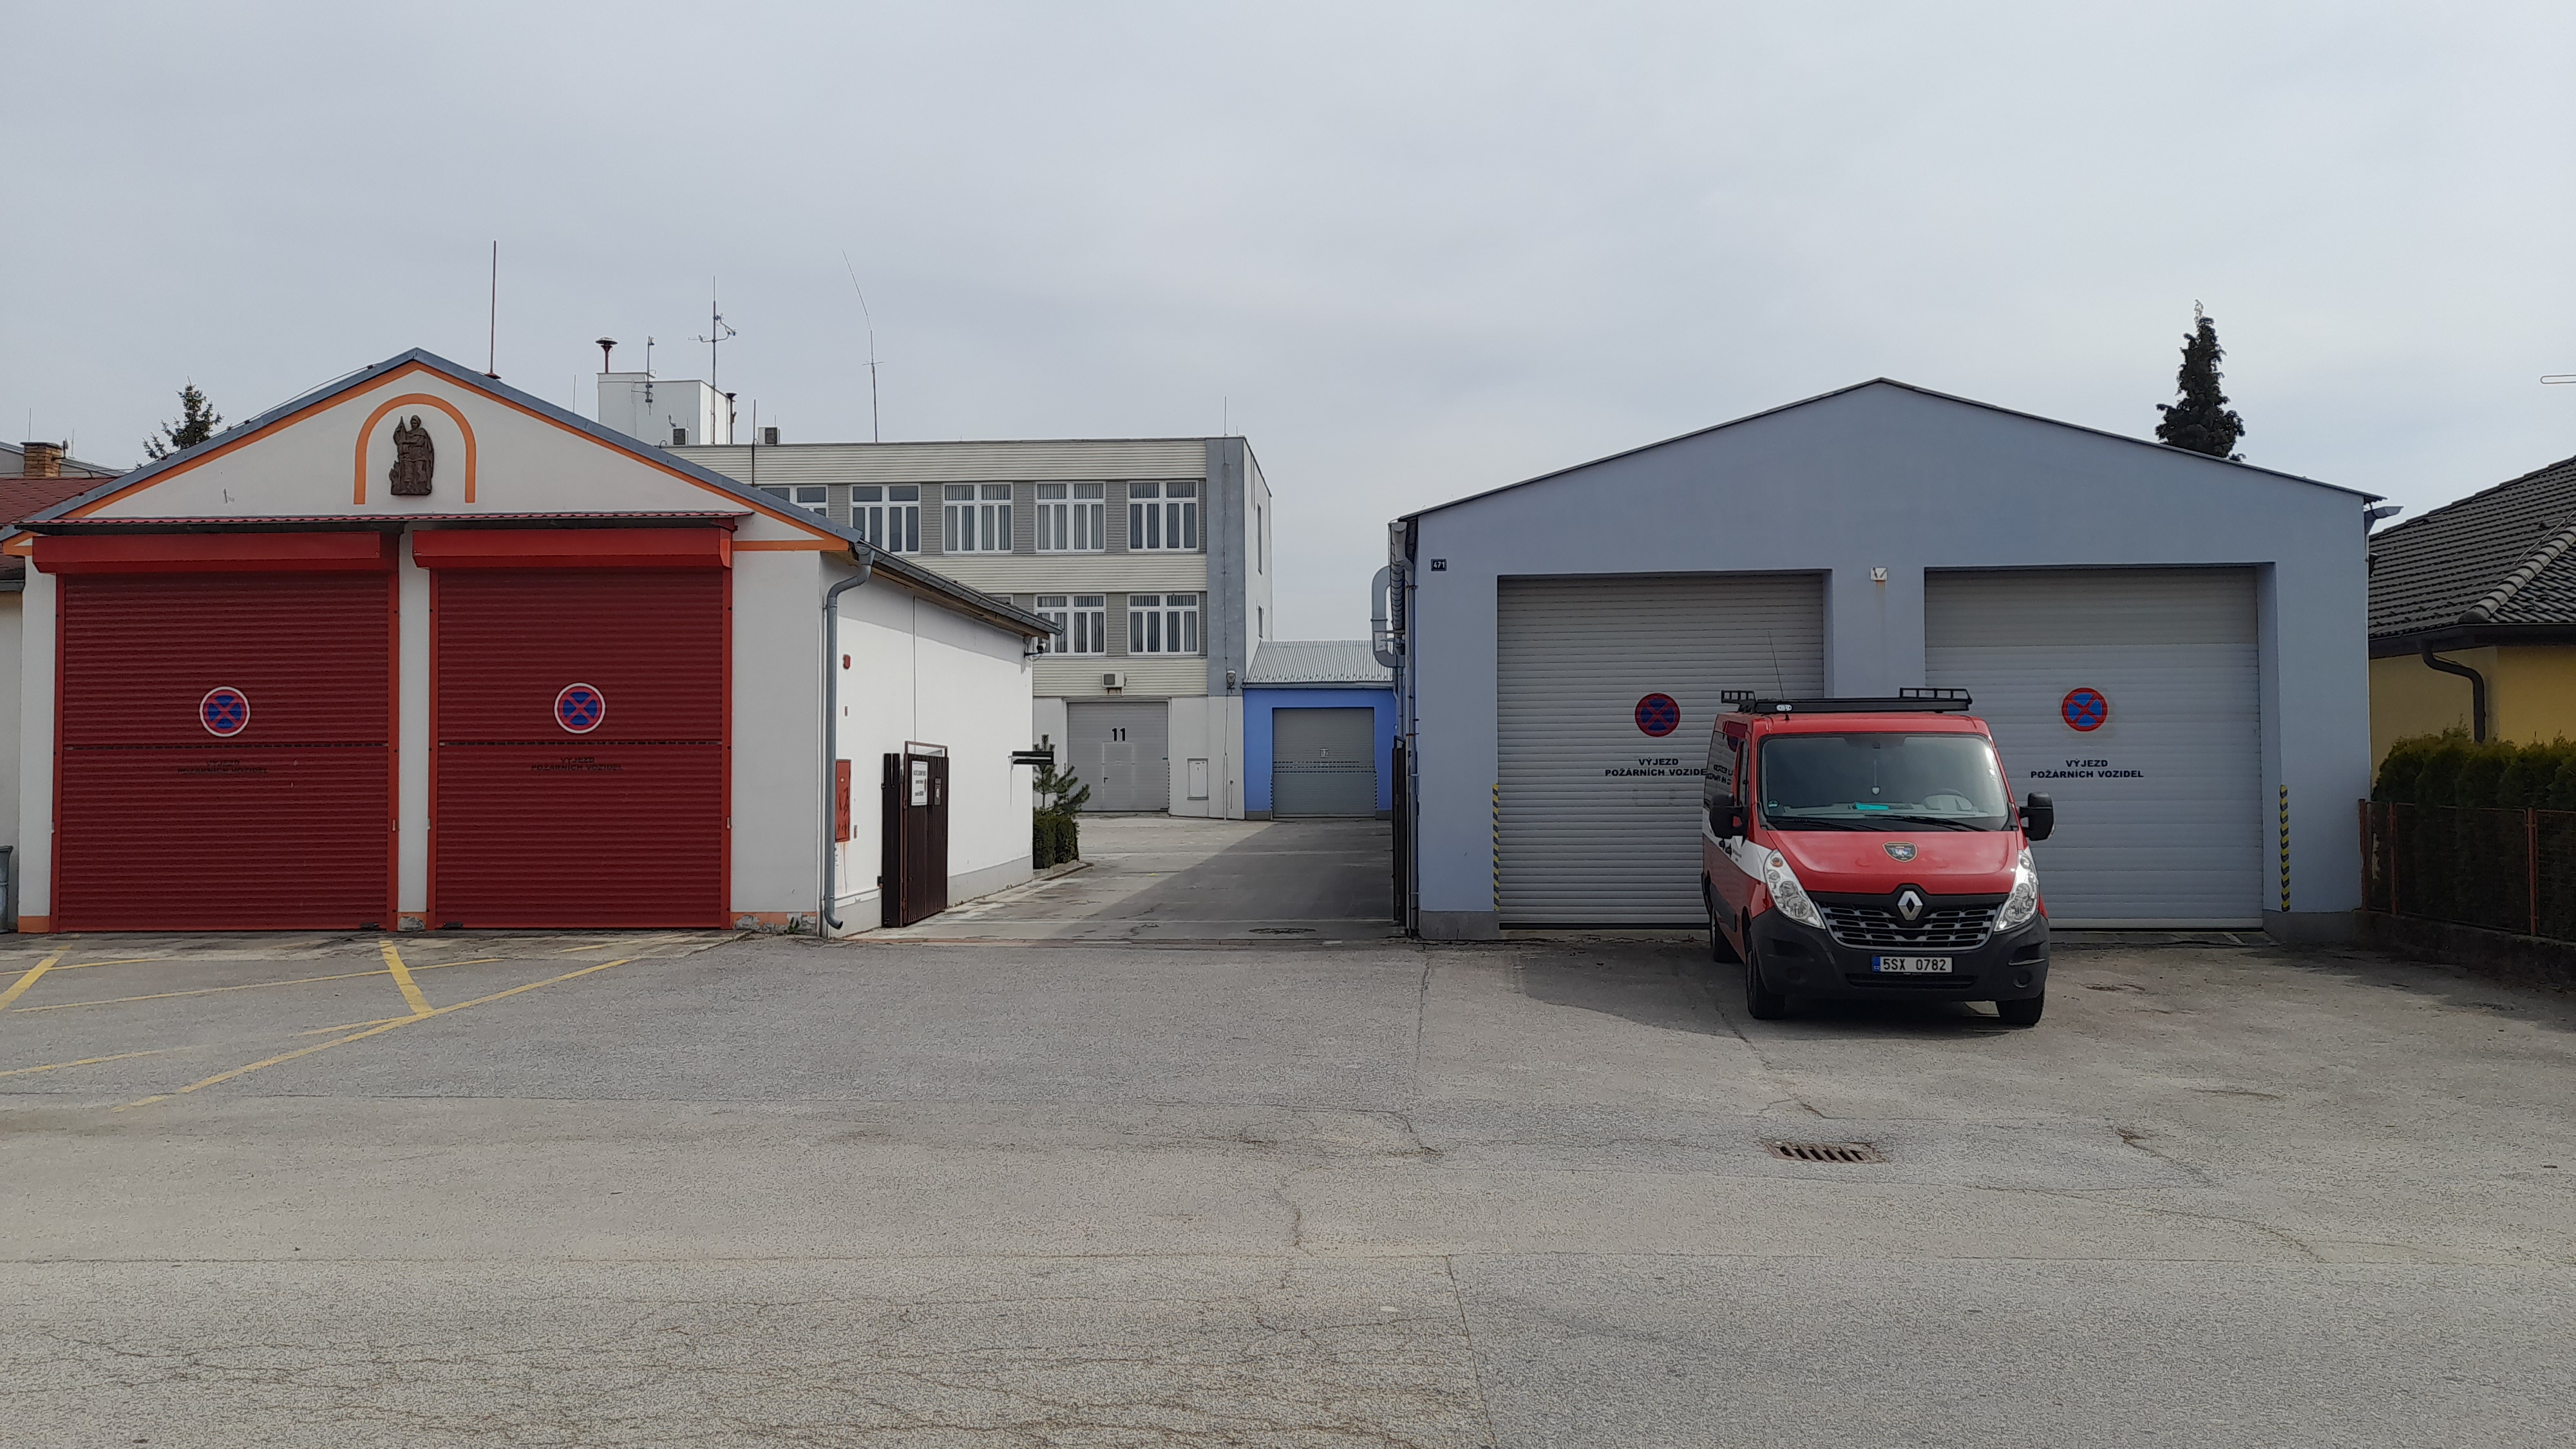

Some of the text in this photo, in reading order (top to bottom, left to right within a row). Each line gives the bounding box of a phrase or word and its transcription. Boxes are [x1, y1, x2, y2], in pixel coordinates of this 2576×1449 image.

[1112, 727, 1126, 742] 11
[1638, 757, 1679, 766] VÝJEZD
[2065, 758, 2108, 767] VÝJEZD
[1605, 767, 1665, 777] POŽÁRNÍCH
[2031, 769, 2094, 779] POŽÁRNÍCH
[1883, 958, 1946, 971] 5SX 0782
